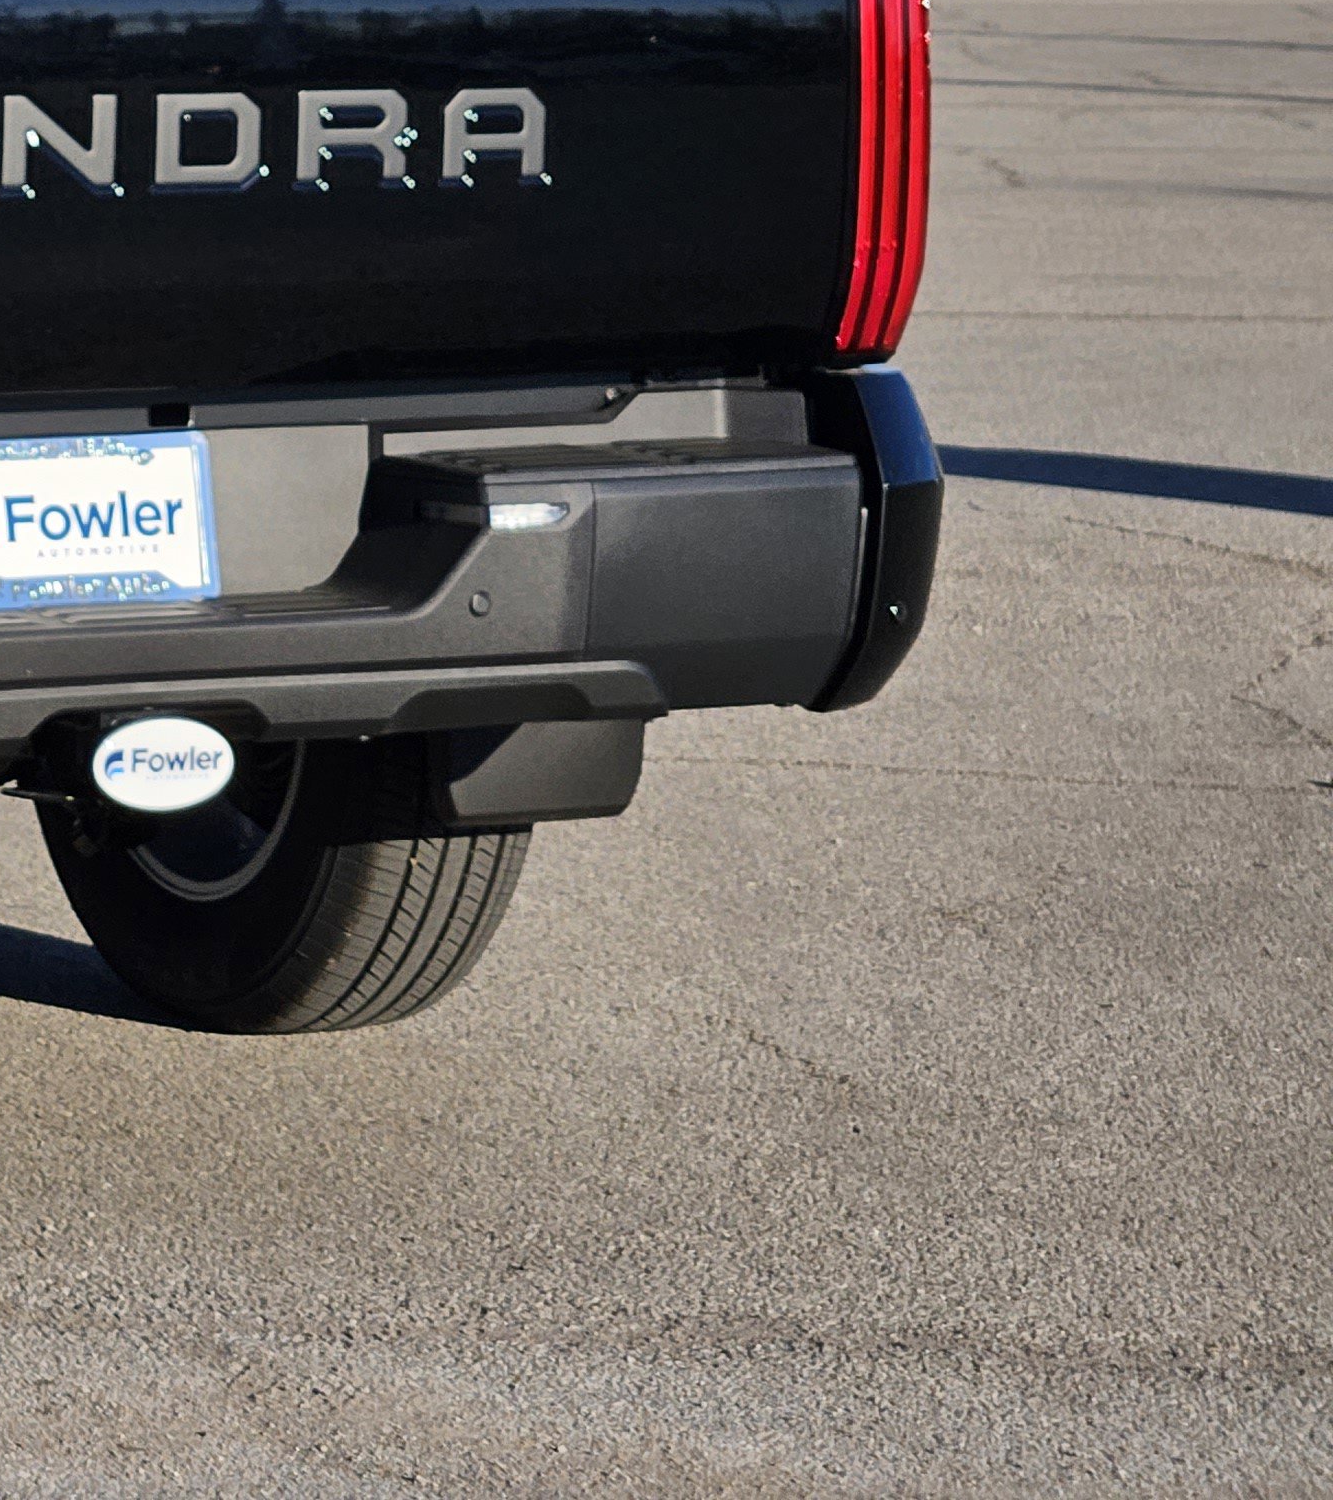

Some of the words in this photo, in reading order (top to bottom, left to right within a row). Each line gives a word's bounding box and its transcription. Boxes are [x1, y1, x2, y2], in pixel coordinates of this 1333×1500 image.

[3, 490, 183, 542] Fowler
[37, 544, 161, 558] AUTOMOTIVE
[131, 746, 223, 773] Fowler
